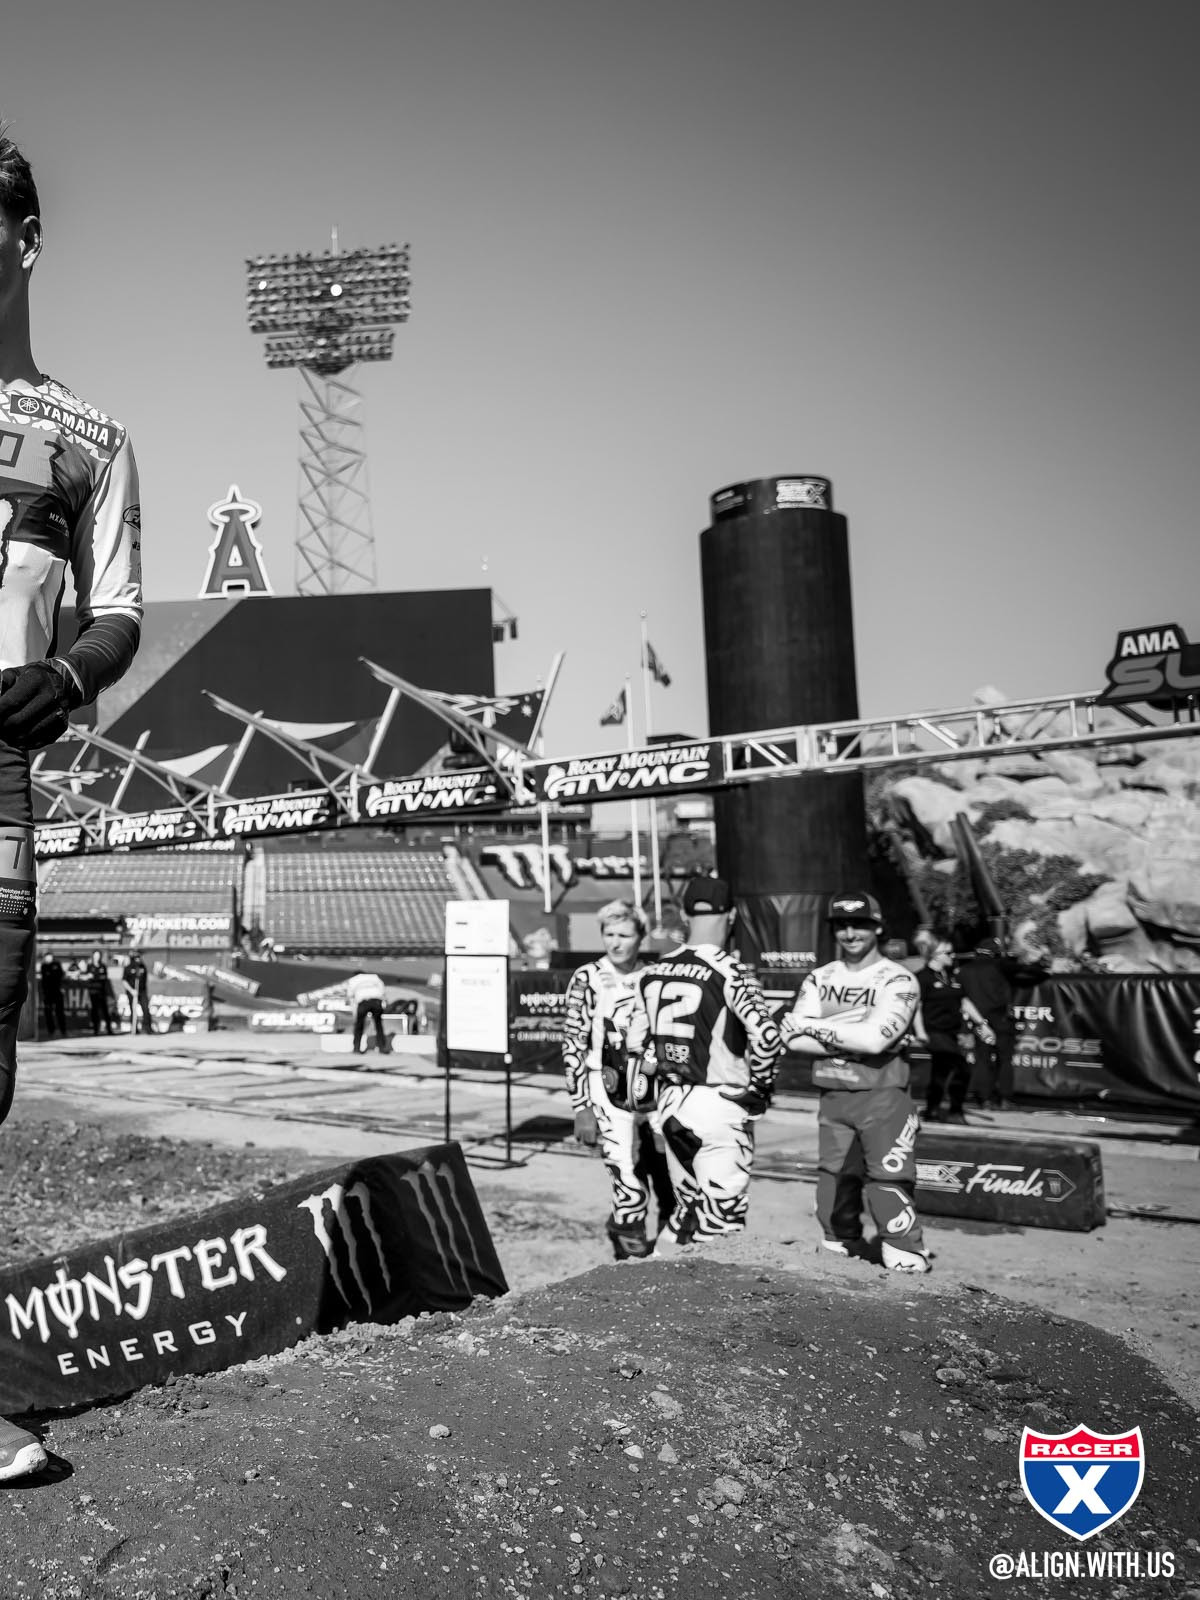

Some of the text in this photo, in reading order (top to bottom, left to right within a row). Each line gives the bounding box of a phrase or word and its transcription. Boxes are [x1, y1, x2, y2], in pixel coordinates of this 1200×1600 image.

[41, 402, 109, 446] YAMAHA
[1121, 630, 1180, 657] AMA
[567, 745, 710, 777] ROCKY MOUNTAIN
[383, 780, 423, 796] ROCKY
[644, 980, 703, 1040] 12
[966, 1163, 1045, 1197] Finals
[4, 1223, 287, 1343] MONSTER
[57, 1311, 248, 1376] ENERGY
